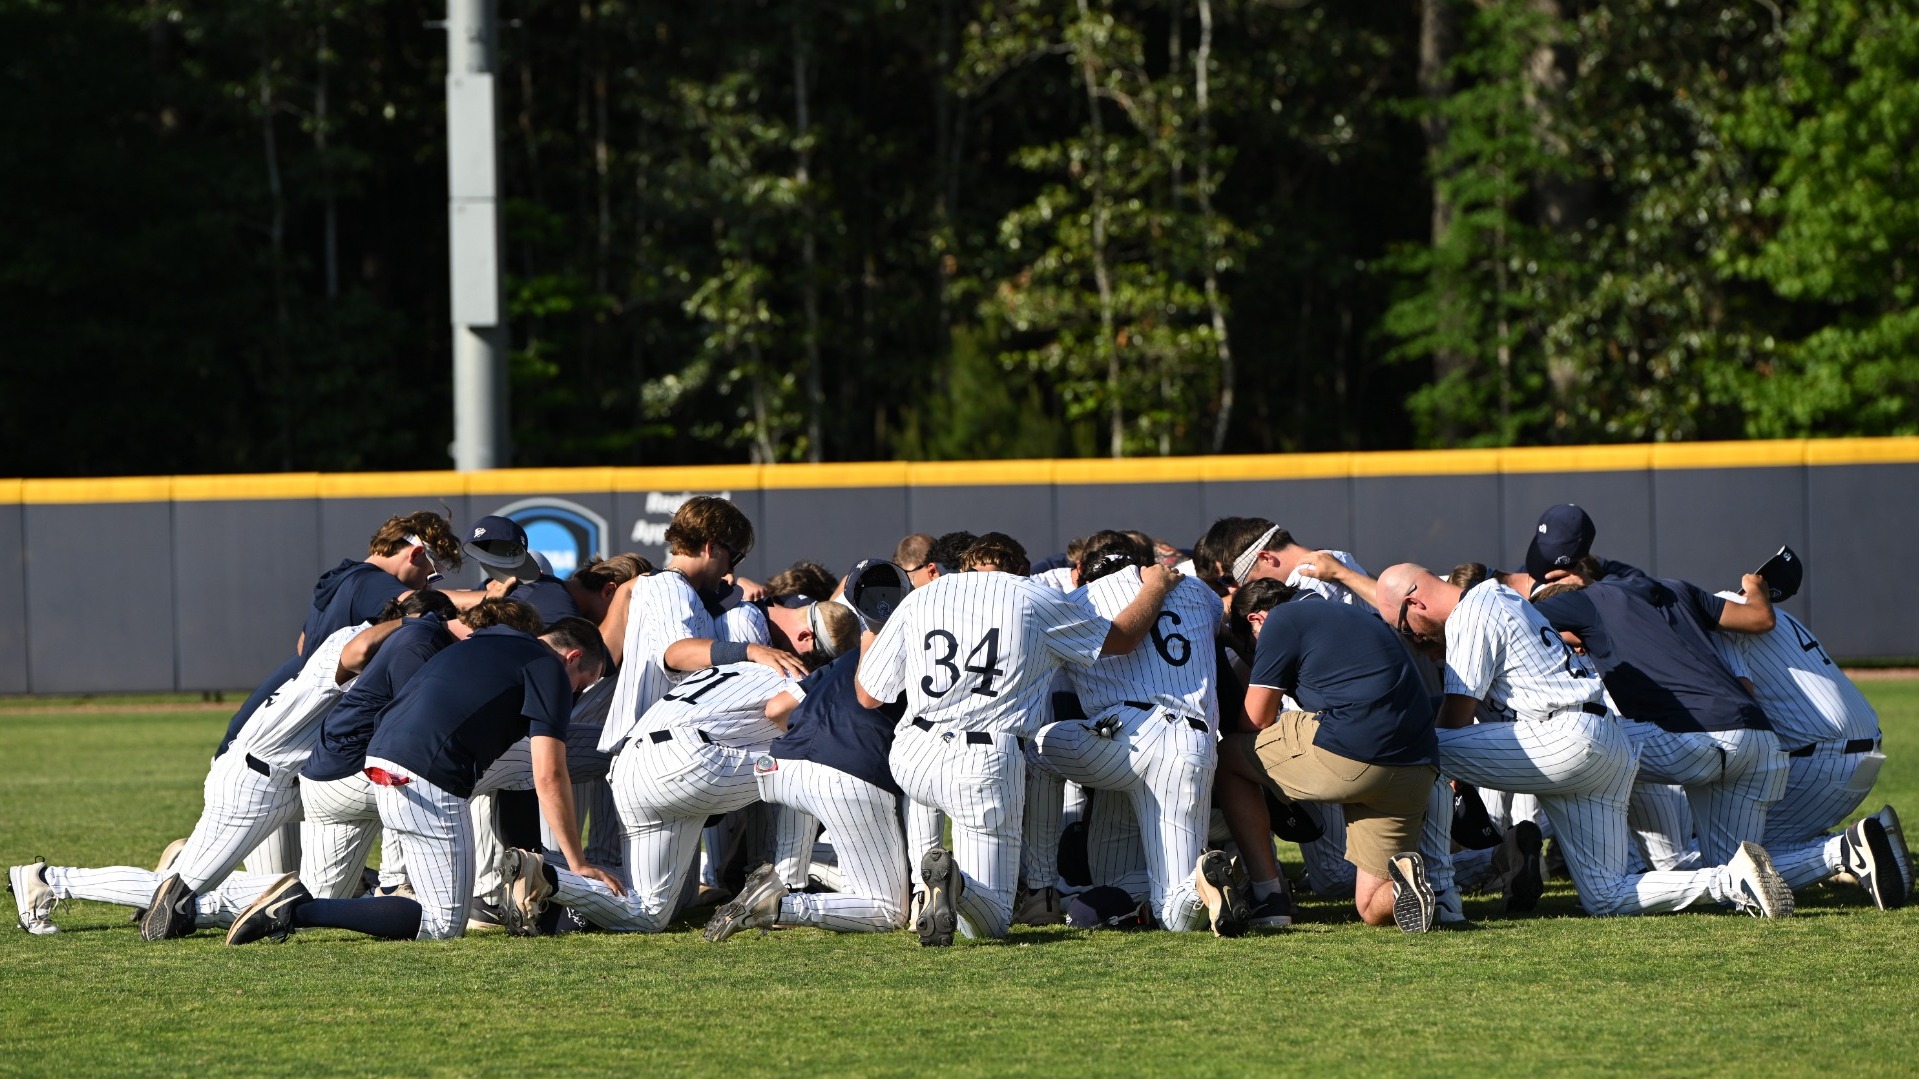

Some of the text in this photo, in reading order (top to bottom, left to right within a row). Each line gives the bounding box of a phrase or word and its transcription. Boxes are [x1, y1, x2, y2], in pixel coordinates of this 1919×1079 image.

[921, 628, 1003, 698] 34
[1150, 611, 1191, 667] 6
[662, 667, 740, 705] 21
